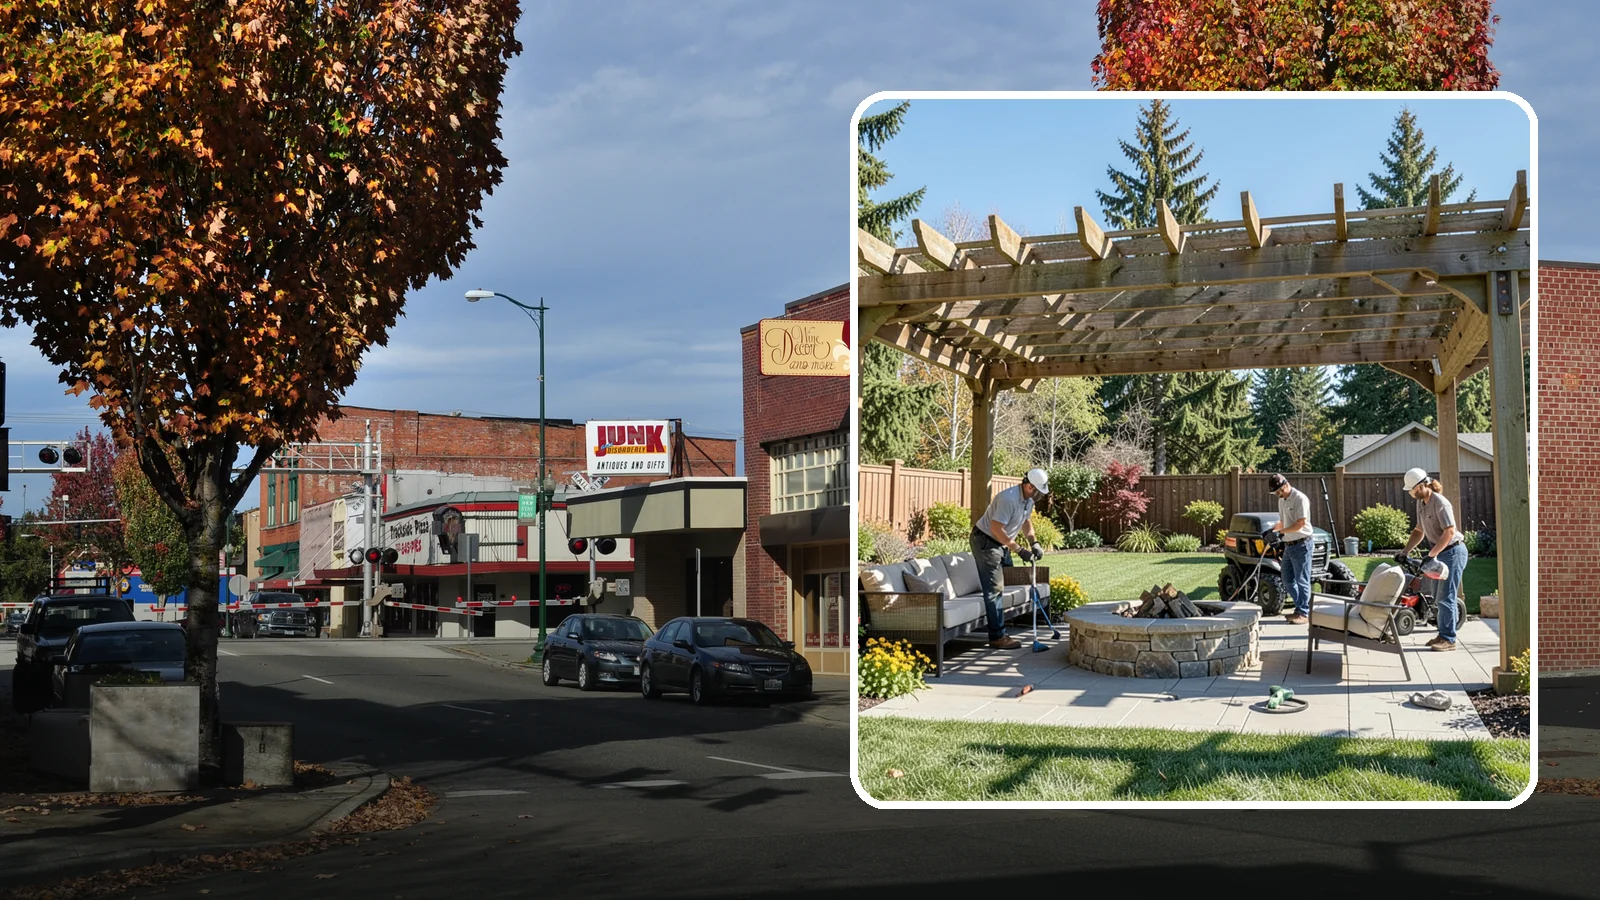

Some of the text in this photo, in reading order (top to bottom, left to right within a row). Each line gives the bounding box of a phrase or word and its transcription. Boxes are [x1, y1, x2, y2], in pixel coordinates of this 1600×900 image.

[596, 425, 665, 457] JUNK
[608, 446, 646, 454] DISORDERLY
[597, 461, 665, 470] ANTIQUES AND GIFTS
[390, 520, 429, 539] Trackside Pizza
